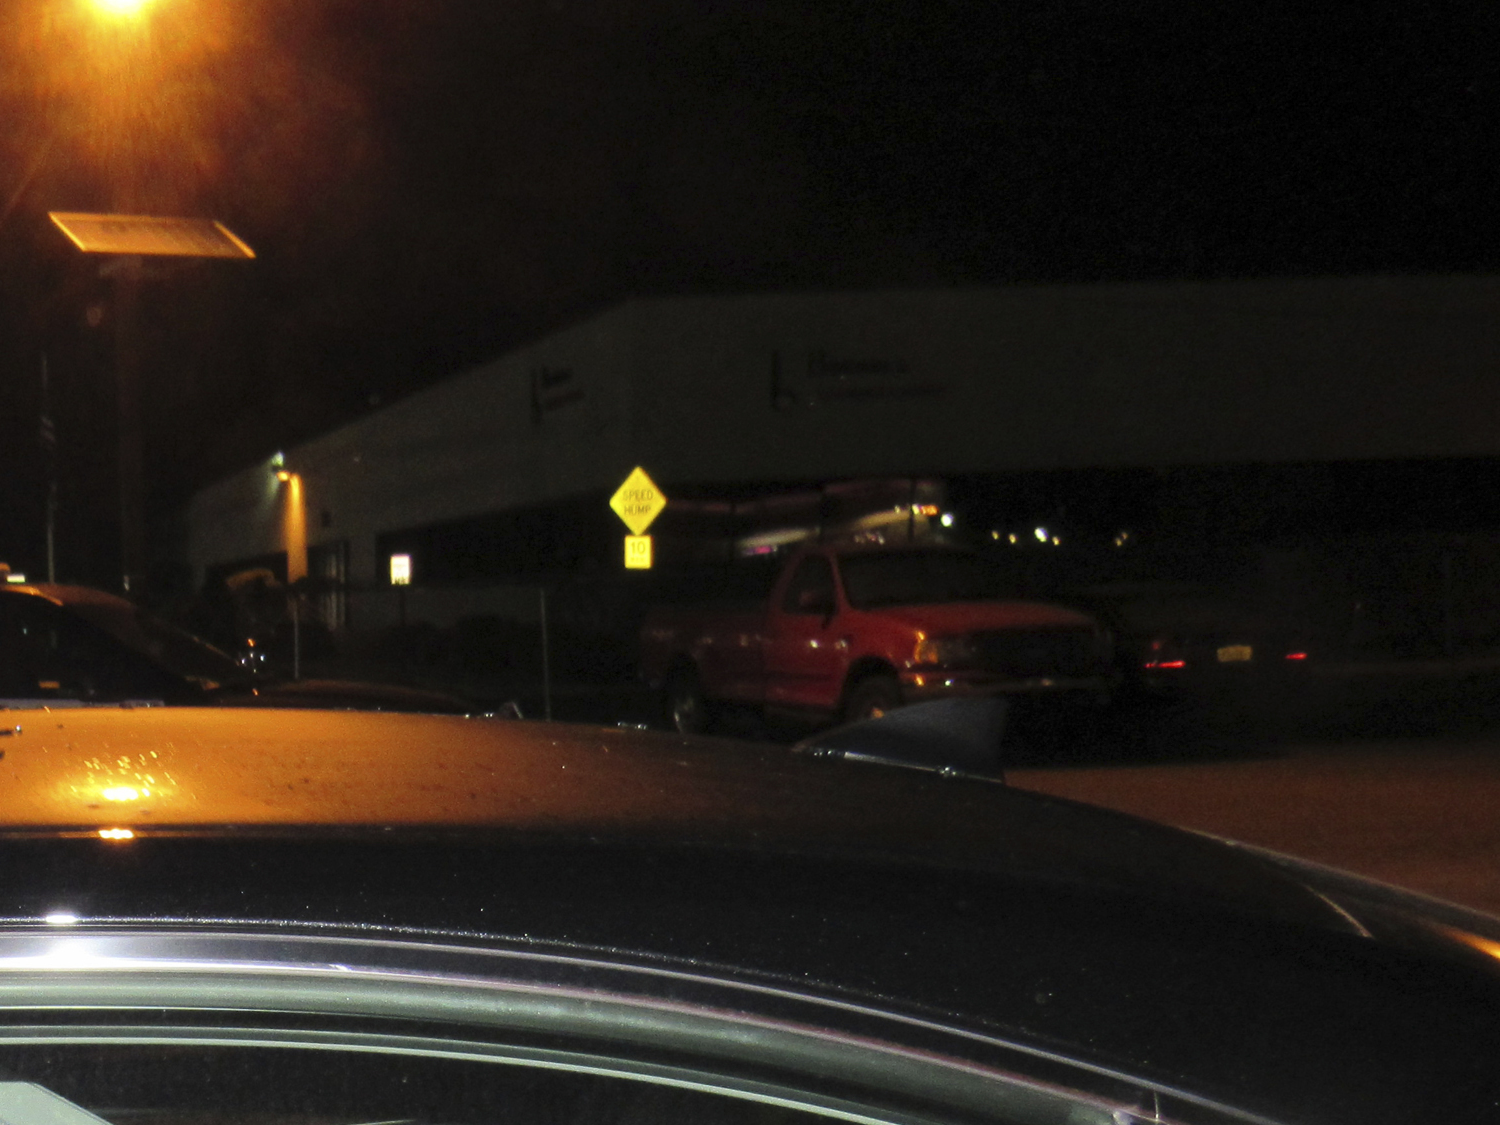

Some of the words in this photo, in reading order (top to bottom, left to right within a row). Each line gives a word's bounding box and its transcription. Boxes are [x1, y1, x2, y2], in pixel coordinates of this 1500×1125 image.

[622, 489, 653, 501] SPEED
[624, 505, 651, 516] HUMP
[630, 541, 646, 554] 10
